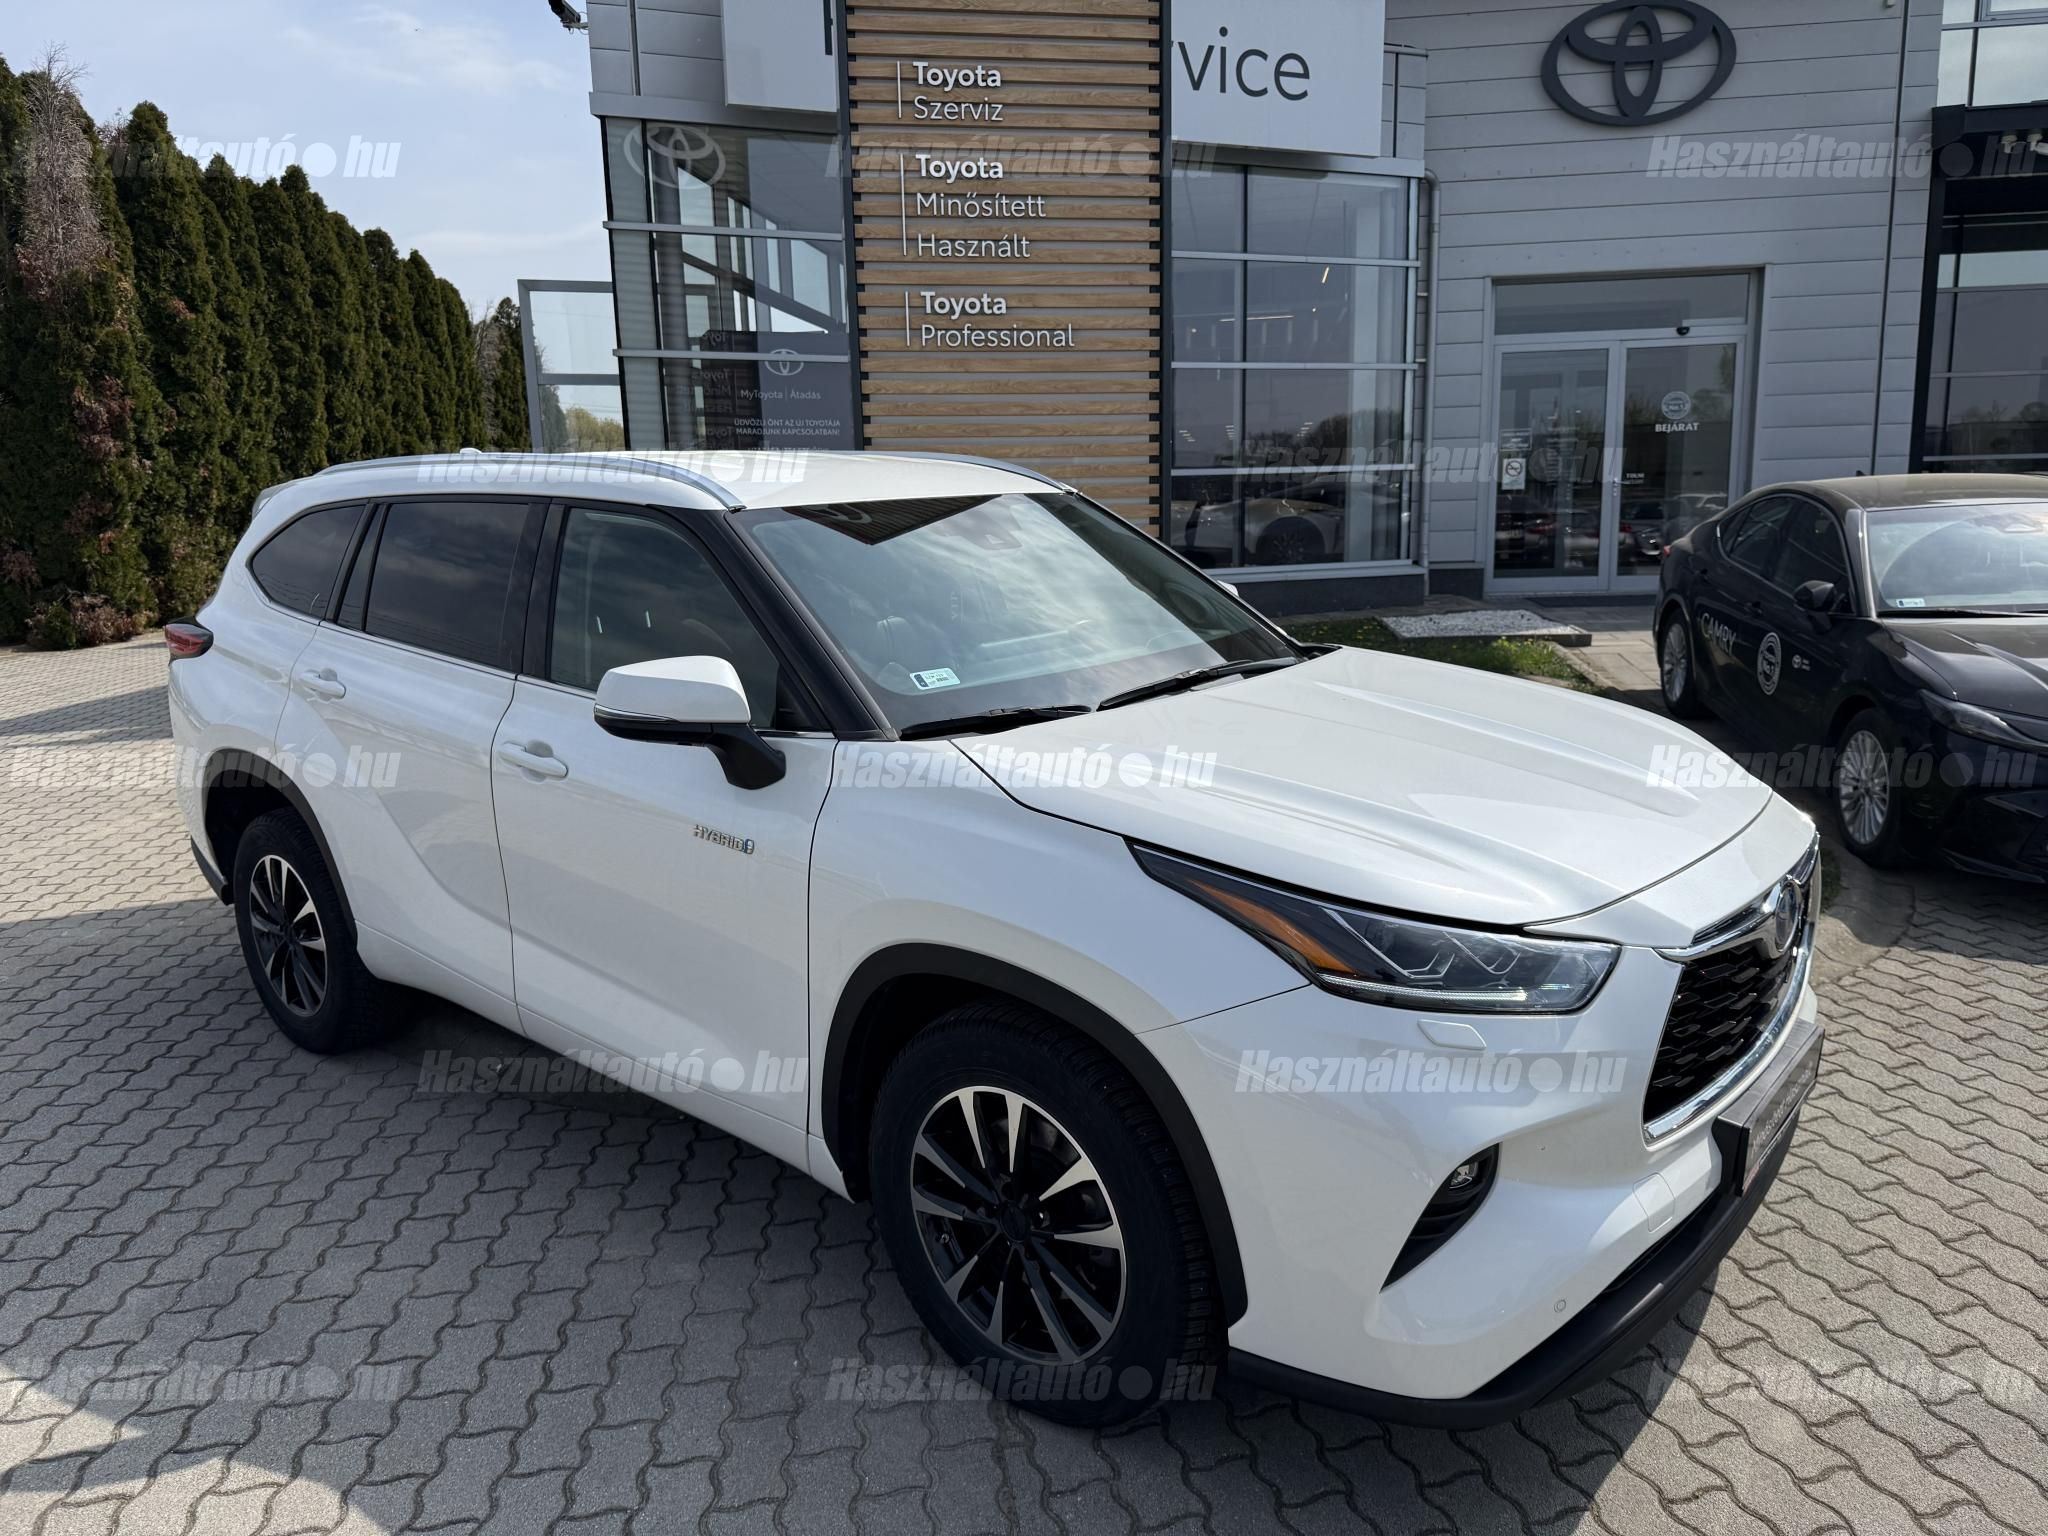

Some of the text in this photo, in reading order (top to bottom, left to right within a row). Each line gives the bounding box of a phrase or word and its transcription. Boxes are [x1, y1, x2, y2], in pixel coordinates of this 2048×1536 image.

[913, 61, 1001, 92] Toyota
[1171, 26, 1310, 101] vice
[914, 95, 1004, 121] Szerviz
[915, 154, 1004, 183] Toyota
[916, 192, 1046, 218] Minősített
[918, 233, 1031, 257] Használt
[920, 291, 1007, 320] Toyota
[921, 323, 1075, 347] Professional
[740, 389, 784, 400] MyToyota
[790, 388, 822, 400] Átadás
[1655, 421, 1700, 434] BEJÁRAT
[1701, 612, 1737, 657] CAMRY
[692, 824, 745, 852] HYBRID
